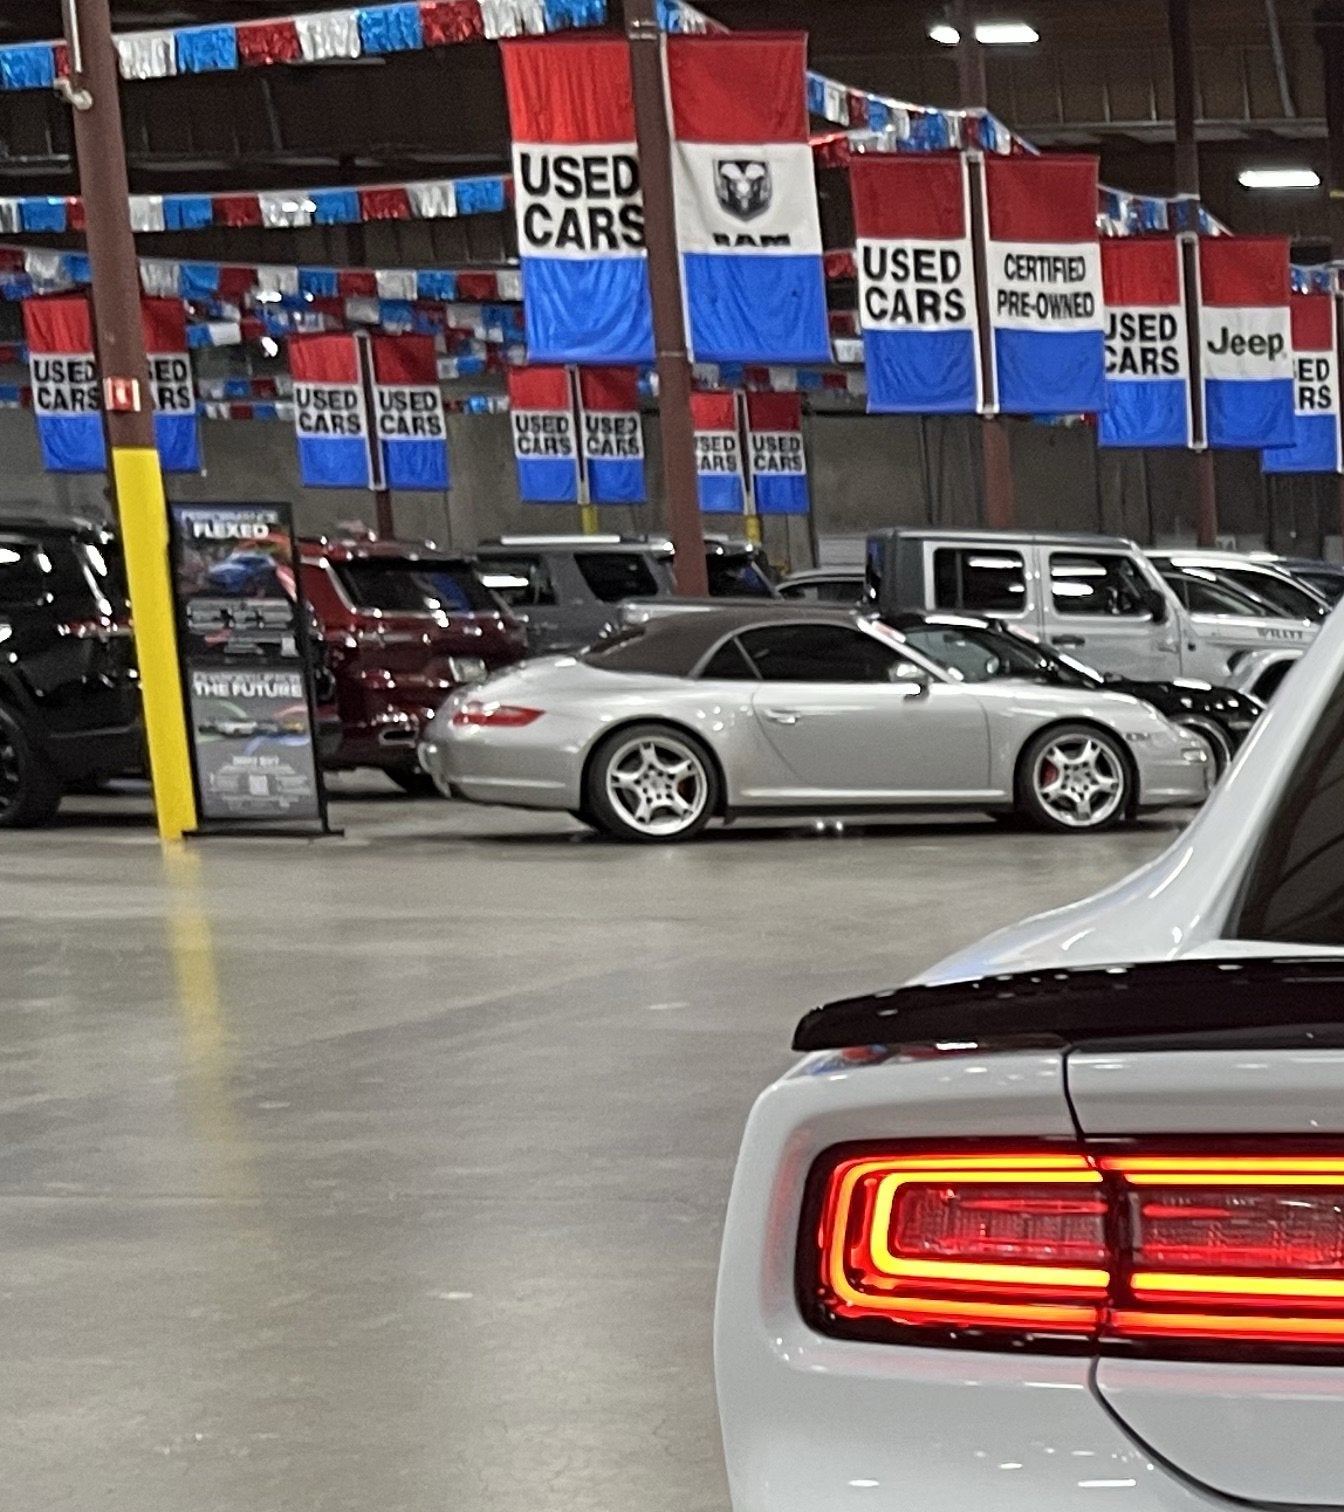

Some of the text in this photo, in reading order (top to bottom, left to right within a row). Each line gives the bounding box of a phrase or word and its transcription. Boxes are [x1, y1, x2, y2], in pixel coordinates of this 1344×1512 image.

[520, 153, 640, 199] USED
[523, 203, 645, 250] CARS
[863, 246, 961, 284] USED
[1004, 253, 1086, 283] CERTIFIED
[865, 286, 966, 323] CARS
[997, 289, 1095, 319] PRE-OWNED
[1207, 326, 1285, 361] Jeep
[33, 358, 96, 383] USED
[149, 359, 188, 382] ED
[1104, 346, 1180, 375] CARS
[1293, 358, 1330, 382] ED
[37, 387, 100, 411] CARS
[155, 386, 190, 410] RS
[296, 388, 358, 411] USED
[378, 390, 438, 412] USED
[1298, 384, 1332, 410] RS
[299, 412, 361, 434] CARS
[380, 414, 442, 435] CARS
[515, 415, 569, 434] USED
[585, 416, 637, 435] USED
[517, 437, 572, 455] CARS
[586, 437, 640, 456] CARS
[696, 435, 736, 452] SED
[752, 435, 800, 453] USED
[699, 454, 737, 472] ARS
[754, 454, 802, 472] CARS
[194, 681, 302, 698] THE FUTURE
